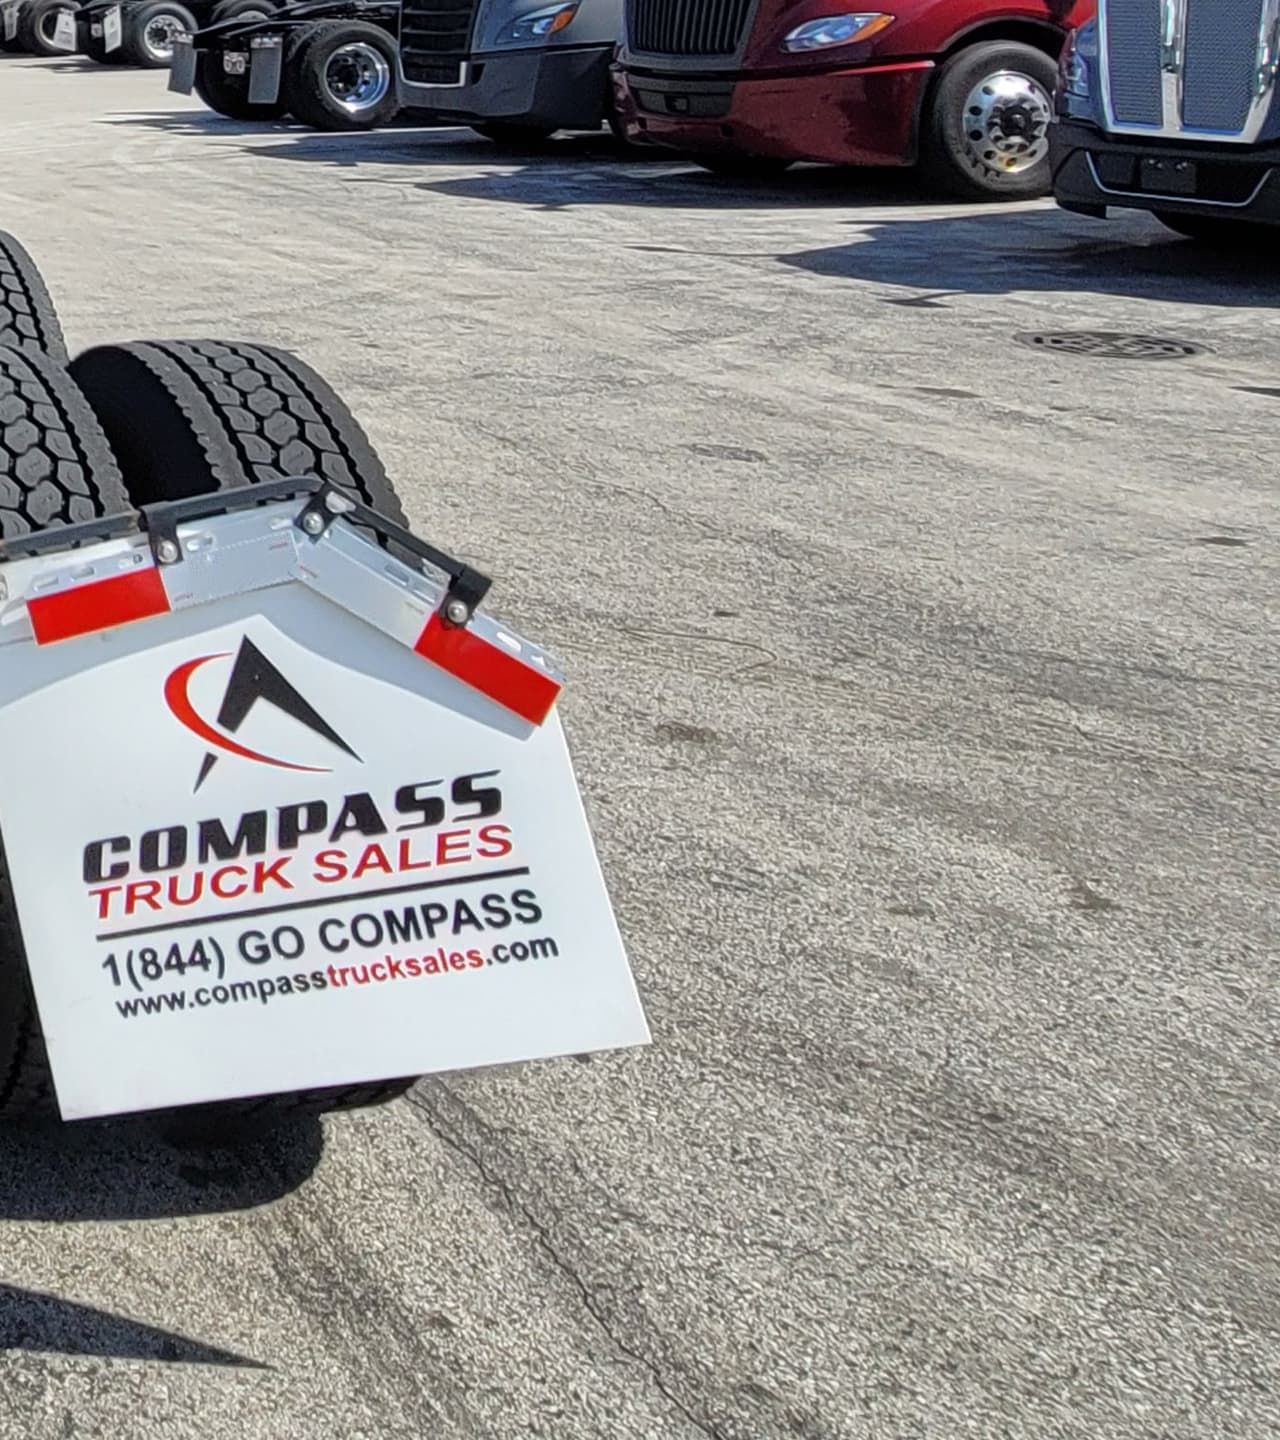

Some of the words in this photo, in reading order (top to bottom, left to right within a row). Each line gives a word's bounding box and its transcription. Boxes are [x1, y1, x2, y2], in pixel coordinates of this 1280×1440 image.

[83, 769, 501, 884] COMPASS
[88, 856, 295, 919] TRUCK
[313, 825, 512, 883] SALES
[102, 936, 225, 992] 1(844)
[238, 925, 305, 964] GO
[319, 889, 542, 953] COMPASS
[116, 937, 558, 1018] www.compasstrucksales.com
